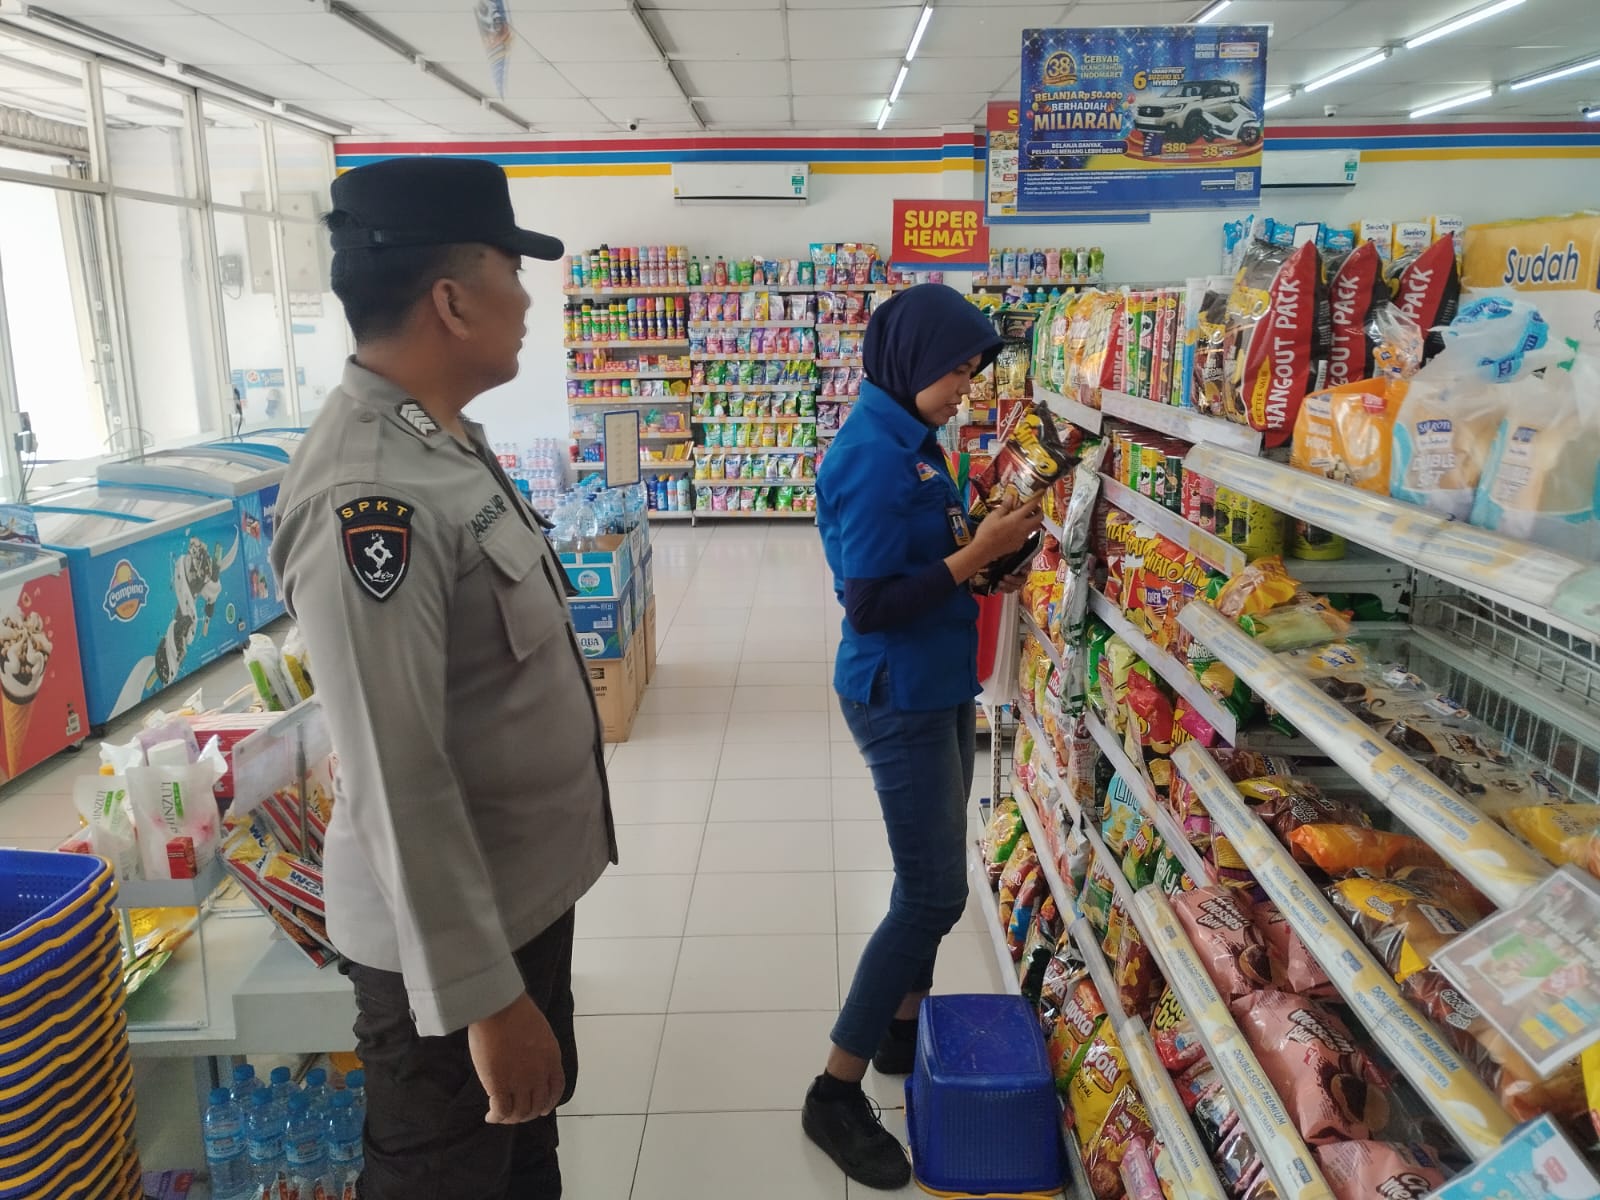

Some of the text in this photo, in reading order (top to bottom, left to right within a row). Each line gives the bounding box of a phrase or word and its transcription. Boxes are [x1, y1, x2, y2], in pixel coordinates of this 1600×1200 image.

[1135, 71, 1147, 90] 6
[1034, 91, 1078, 102] BELANJA
[1051, 102, 1107, 111] BERHADIAH
[1034, 112, 1123, 132] MILIARAN
[904, 210, 978, 228] SUPER
[904, 230, 978, 247] HEMAT
[1504, 241, 1580, 285] Sudah
[1333, 275, 1360, 325] PACK
[1401, 266, 1433, 319] PACK
[1266, 279, 1300, 429] HANGOUT PACK
[341, 500, 409, 519] SPKT
[109, 584, 144, 608] Campina
[580, 637, 600, 647] QUA
[1370, 986, 1460, 1073] DOUBLE SOFT PREMIUM
[1232, 1048, 1287, 1126] DOUBLE SOFT PREMIUM
